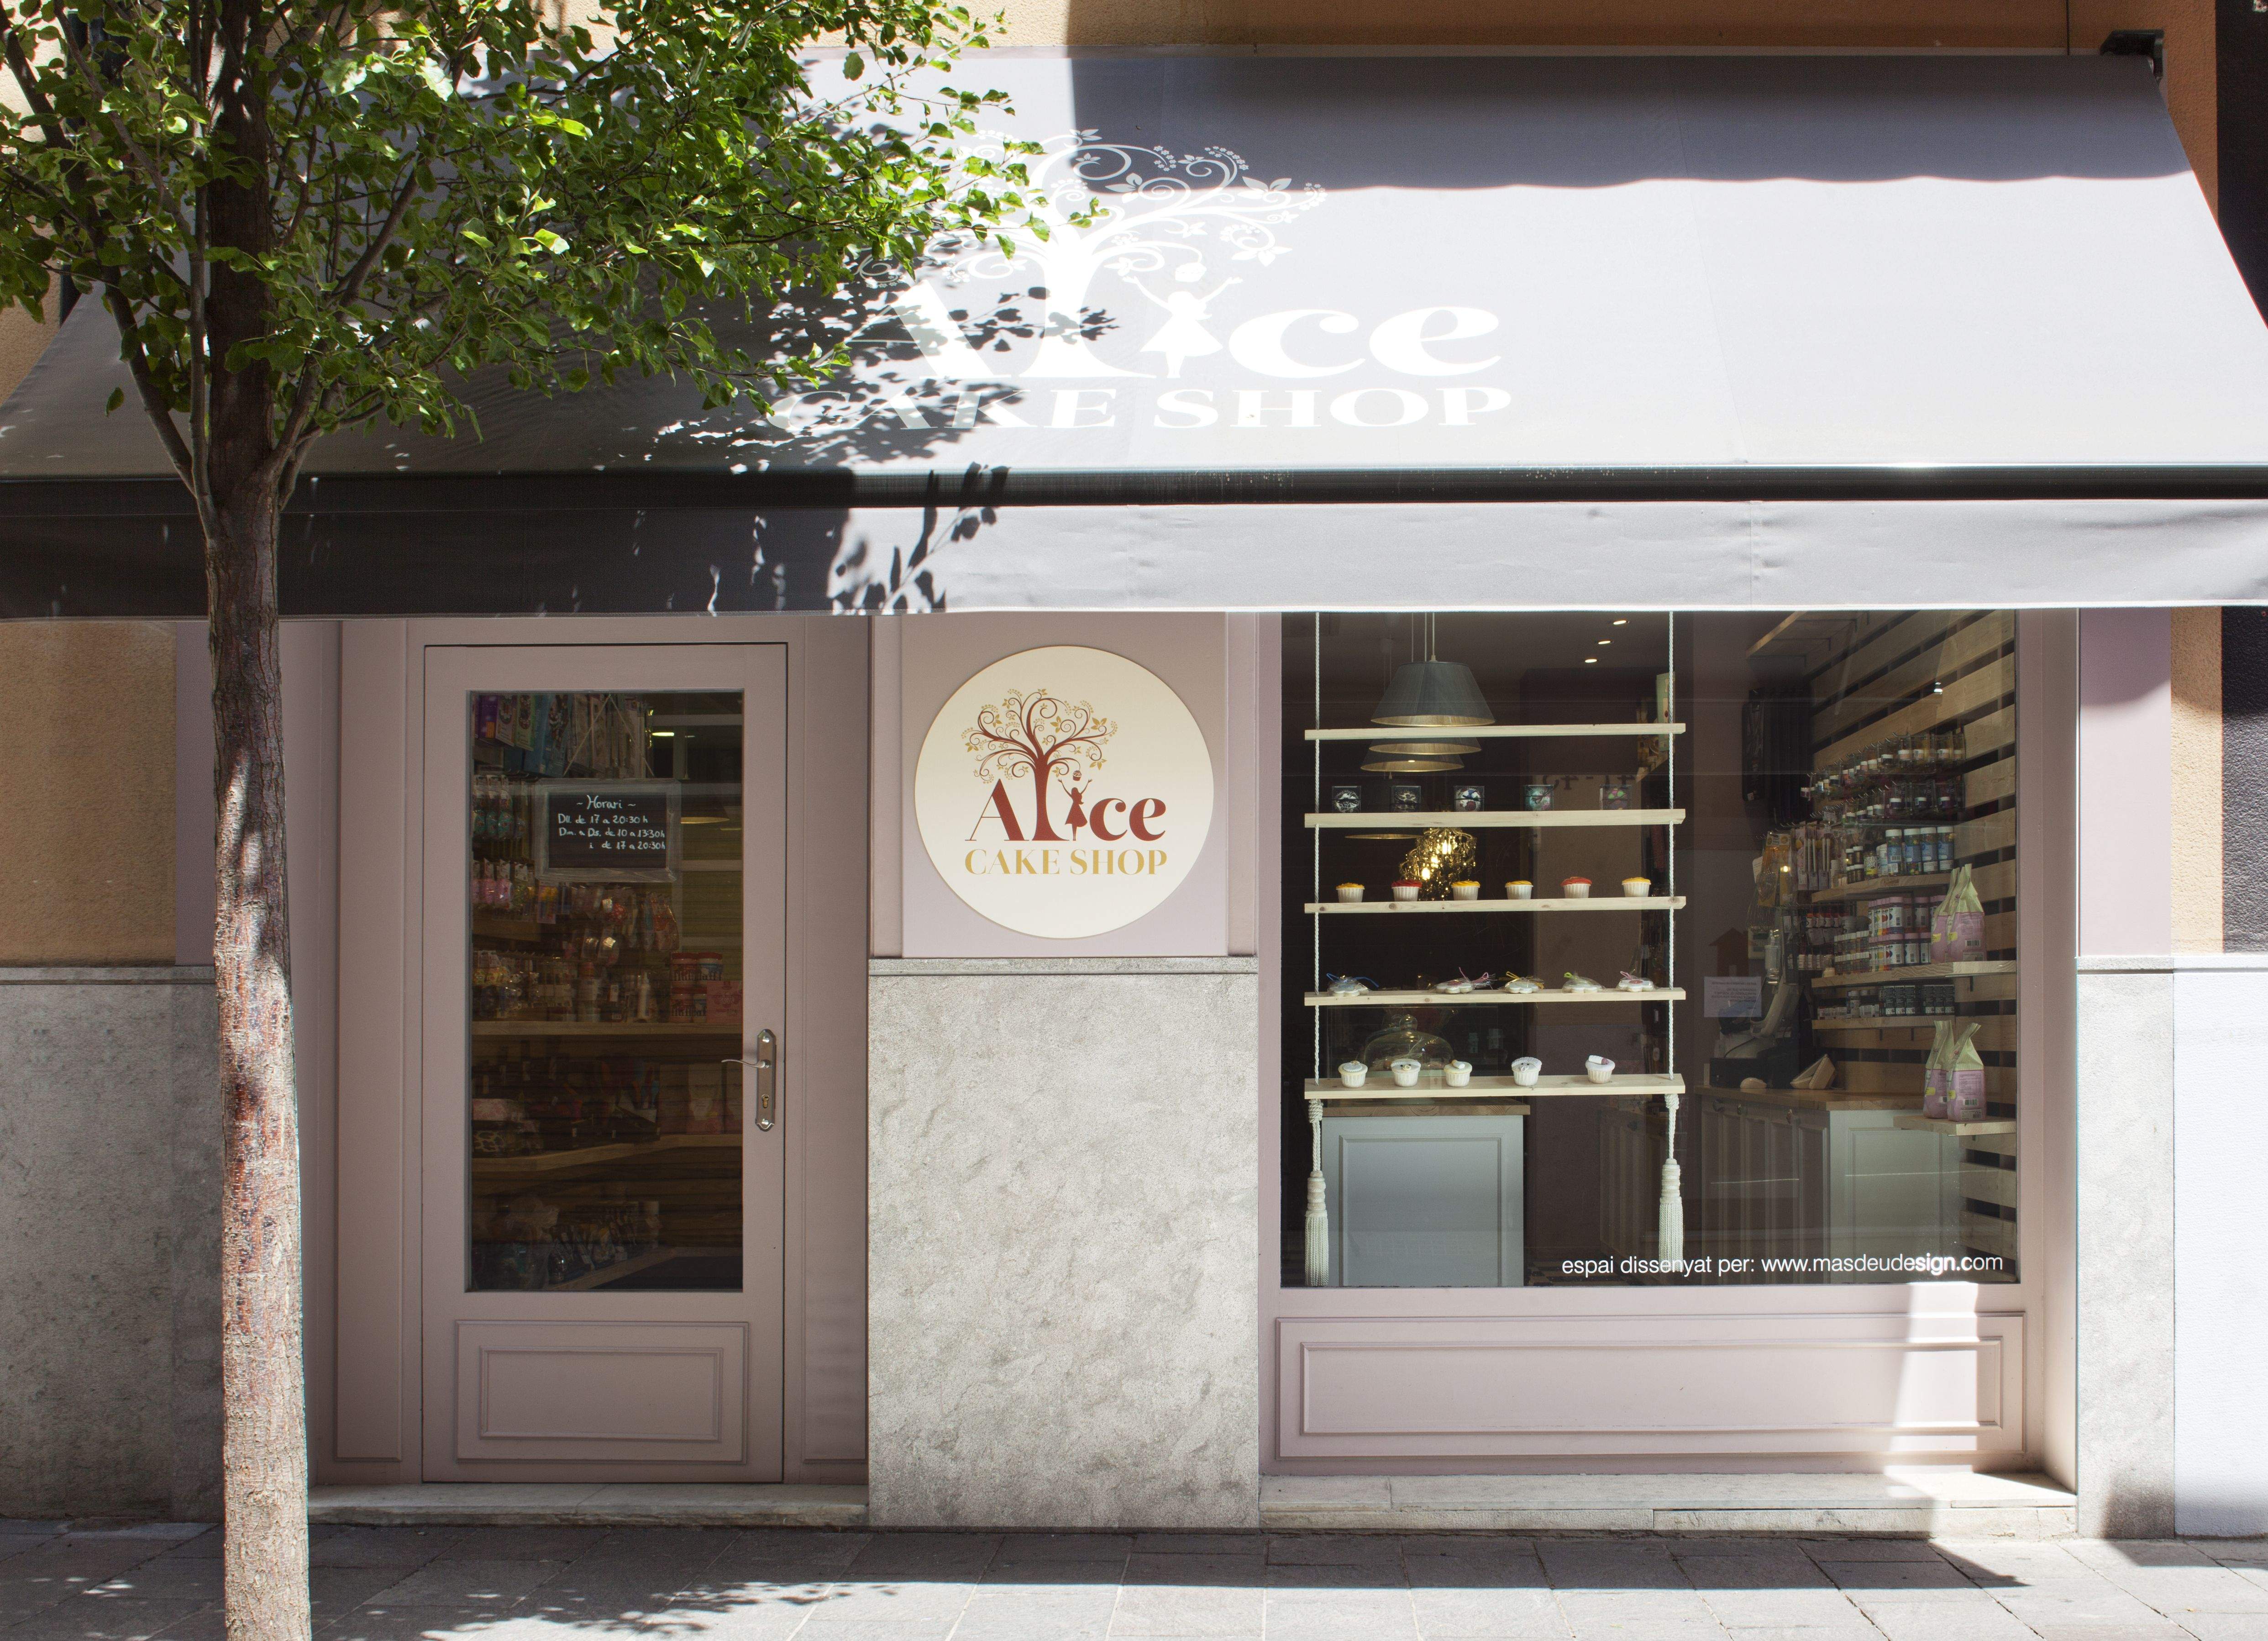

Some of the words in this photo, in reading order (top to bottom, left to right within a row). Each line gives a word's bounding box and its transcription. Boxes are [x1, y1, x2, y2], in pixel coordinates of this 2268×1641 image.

[766, 388, 1117, 430] CAKE
[1153, 386, 1512, 429] SHOP
[587, 795, 622, 810] Horari
[964, 756, 1166, 842] Alice
[576, 815, 586, 824] de
[591, 815, 600, 823] 17
[613, 815, 640, 824] 20:30
[605, 827, 615, 836] de
[965, 848, 1060, 875] CAKE
[1070, 849, 1167, 875] SHOP
[1562, 1256, 1614, 1278] espai
[1620, 1256, 1712, 1277] dissenyat
[1718, 1258, 1754, 1277] per:
[1761, 1252, 2003, 1276] www.masdeudesign.com
